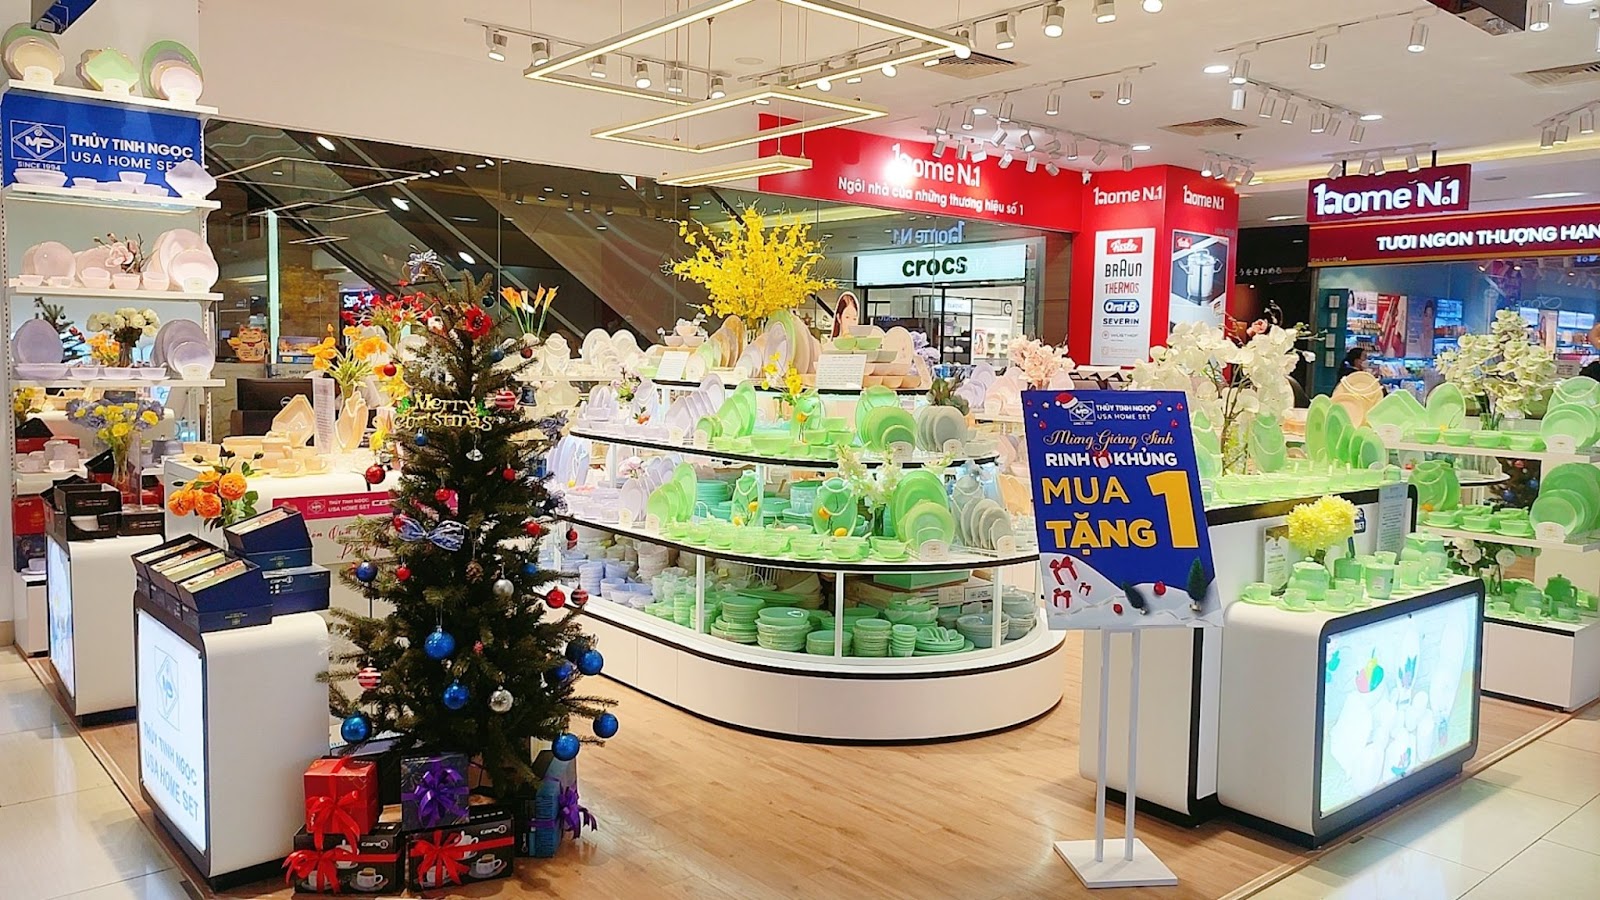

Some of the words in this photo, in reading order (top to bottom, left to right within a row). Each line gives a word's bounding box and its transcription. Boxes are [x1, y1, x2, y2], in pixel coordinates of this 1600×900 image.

[70, 132, 109, 149] THỦY
[112, 138, 146, 152] TINH
[148, 142, 193, 161] NGỌC
[71, 152, 103, 165] USA
[108, 154, 151, 170] HOME
[838, 176, 865, 194] Ngôi
[868, 182, 889, 196] nhà
[915, 187, 948, 208] những
[949, 194, 983, 213] thương
[985, 200, 1004, 216] hiệu
[1006, 201, 1018, 215] số
[1019, 204, 1024, 216] 1
[1377, 234, 1416, 251] TƯƠI
[1419, 230, 1473, 248] NGON
[1476, 226, 1558, 247] THƯỢNG
[902, 256, 967, 277] crocs
[1105, 258, 1142, 277] BRAUN
[1105, 282, 1139, 294] THERMOS
[1105, 301, 1137, 312] Oral-B
[414, 392, 477, 414] Merry
[1092, 429, 1139, 451] Giáng
[1141, 429, 1175, 446] Sinh
[1045, 453, 1090, 466] RINH
[1114, 447, 1178, 466] KHỦNG
[1041, 476, 1130, 504] MUA
[1146, 470, 1199, 548] 1
[1045, 512, 1157, 555] TẶNG
[144, 749, 159, 780] USA
[160, 766, 180, 805] HOME
[182, 791, 199, 822] SET
